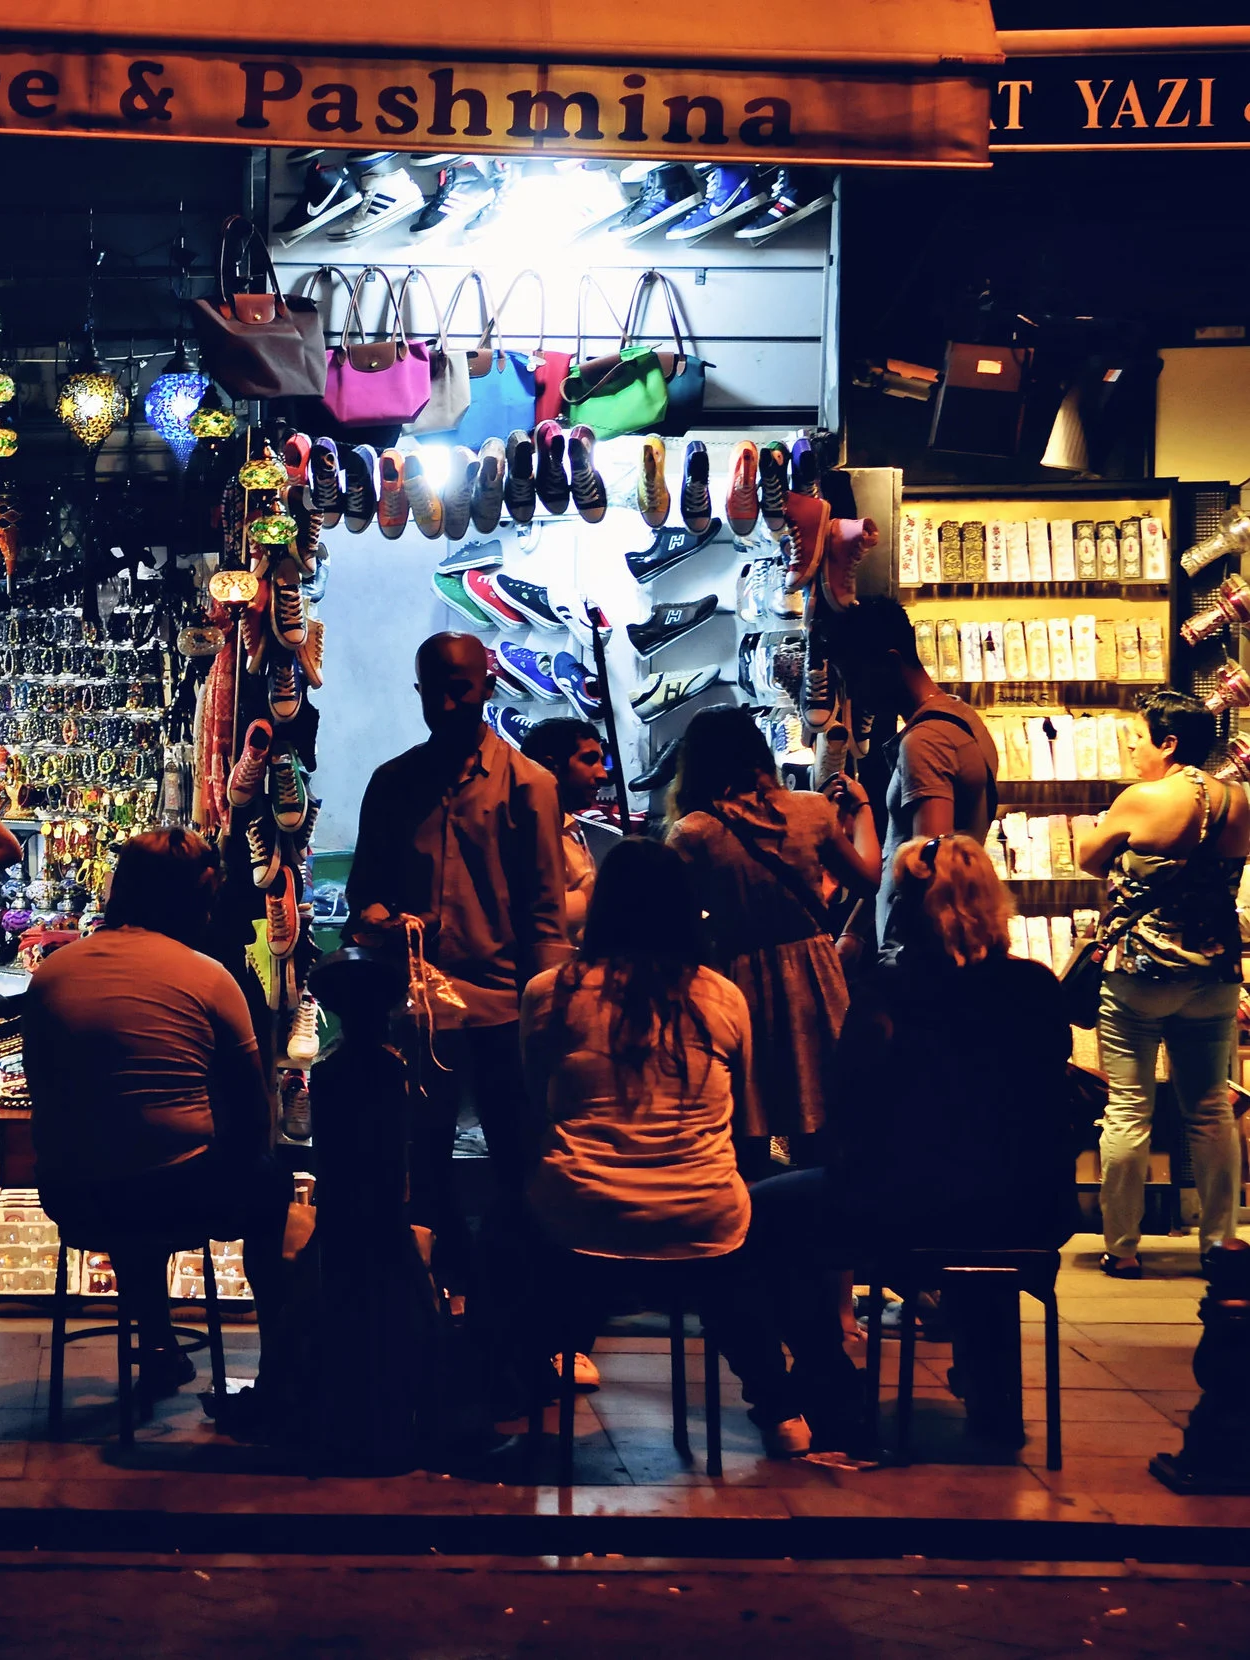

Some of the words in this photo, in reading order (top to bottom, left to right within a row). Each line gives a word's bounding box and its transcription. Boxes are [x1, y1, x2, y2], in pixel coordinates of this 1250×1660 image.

[120, 60, 174, 122] &
[236, 61, 793, 146] Pashmina
[990, 79, 1033, 129] T
[1074, 77, 1217, 129] YAZI
